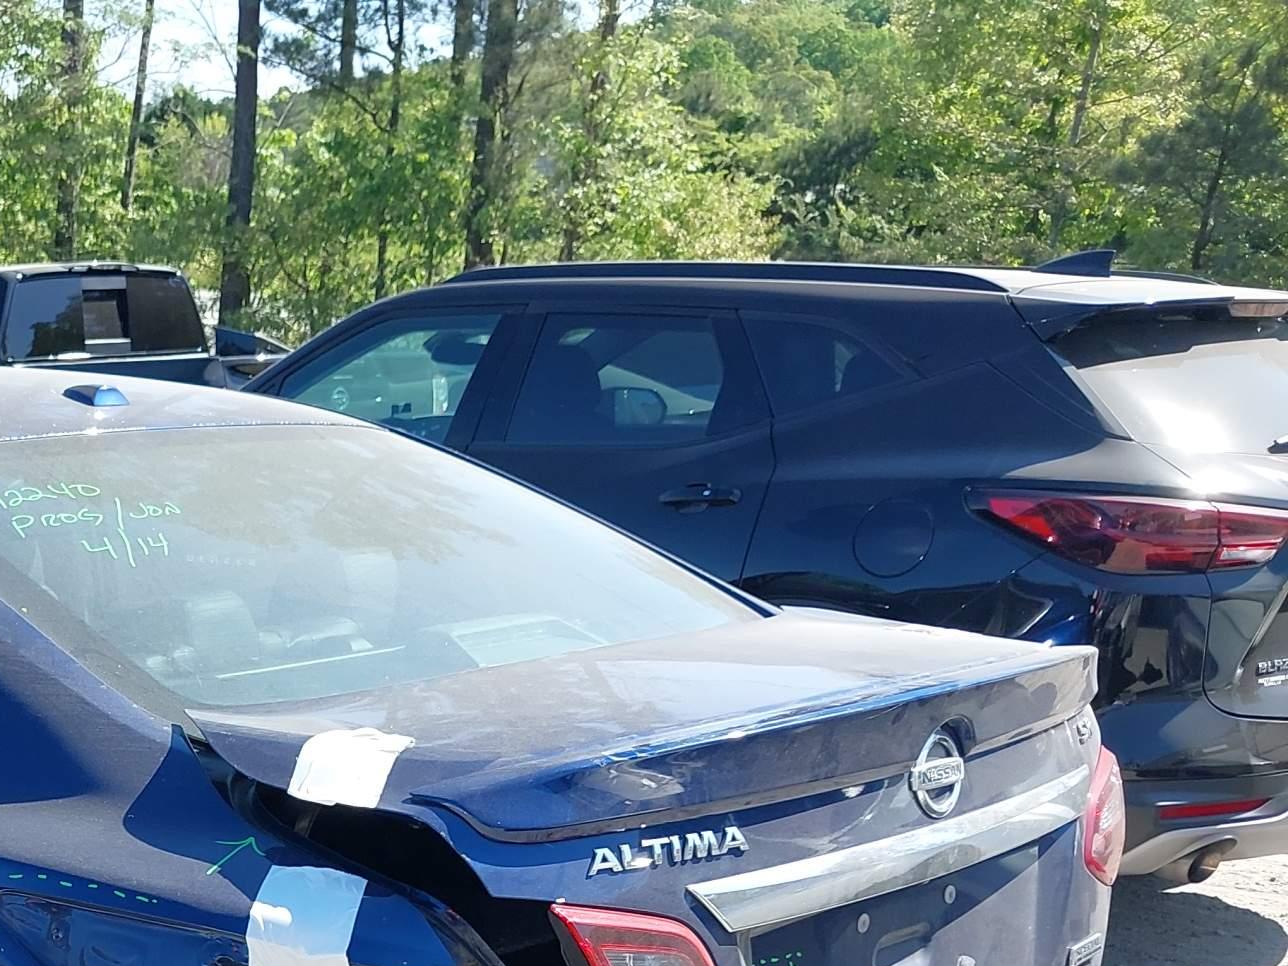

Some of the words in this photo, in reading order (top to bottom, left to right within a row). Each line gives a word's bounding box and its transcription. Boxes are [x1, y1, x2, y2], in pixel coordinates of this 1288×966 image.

[79, 527, 169, 568] 4/14
[918, 762, 961, 785] NISSAN
[587, 825, 750, 877] ALTIMA
